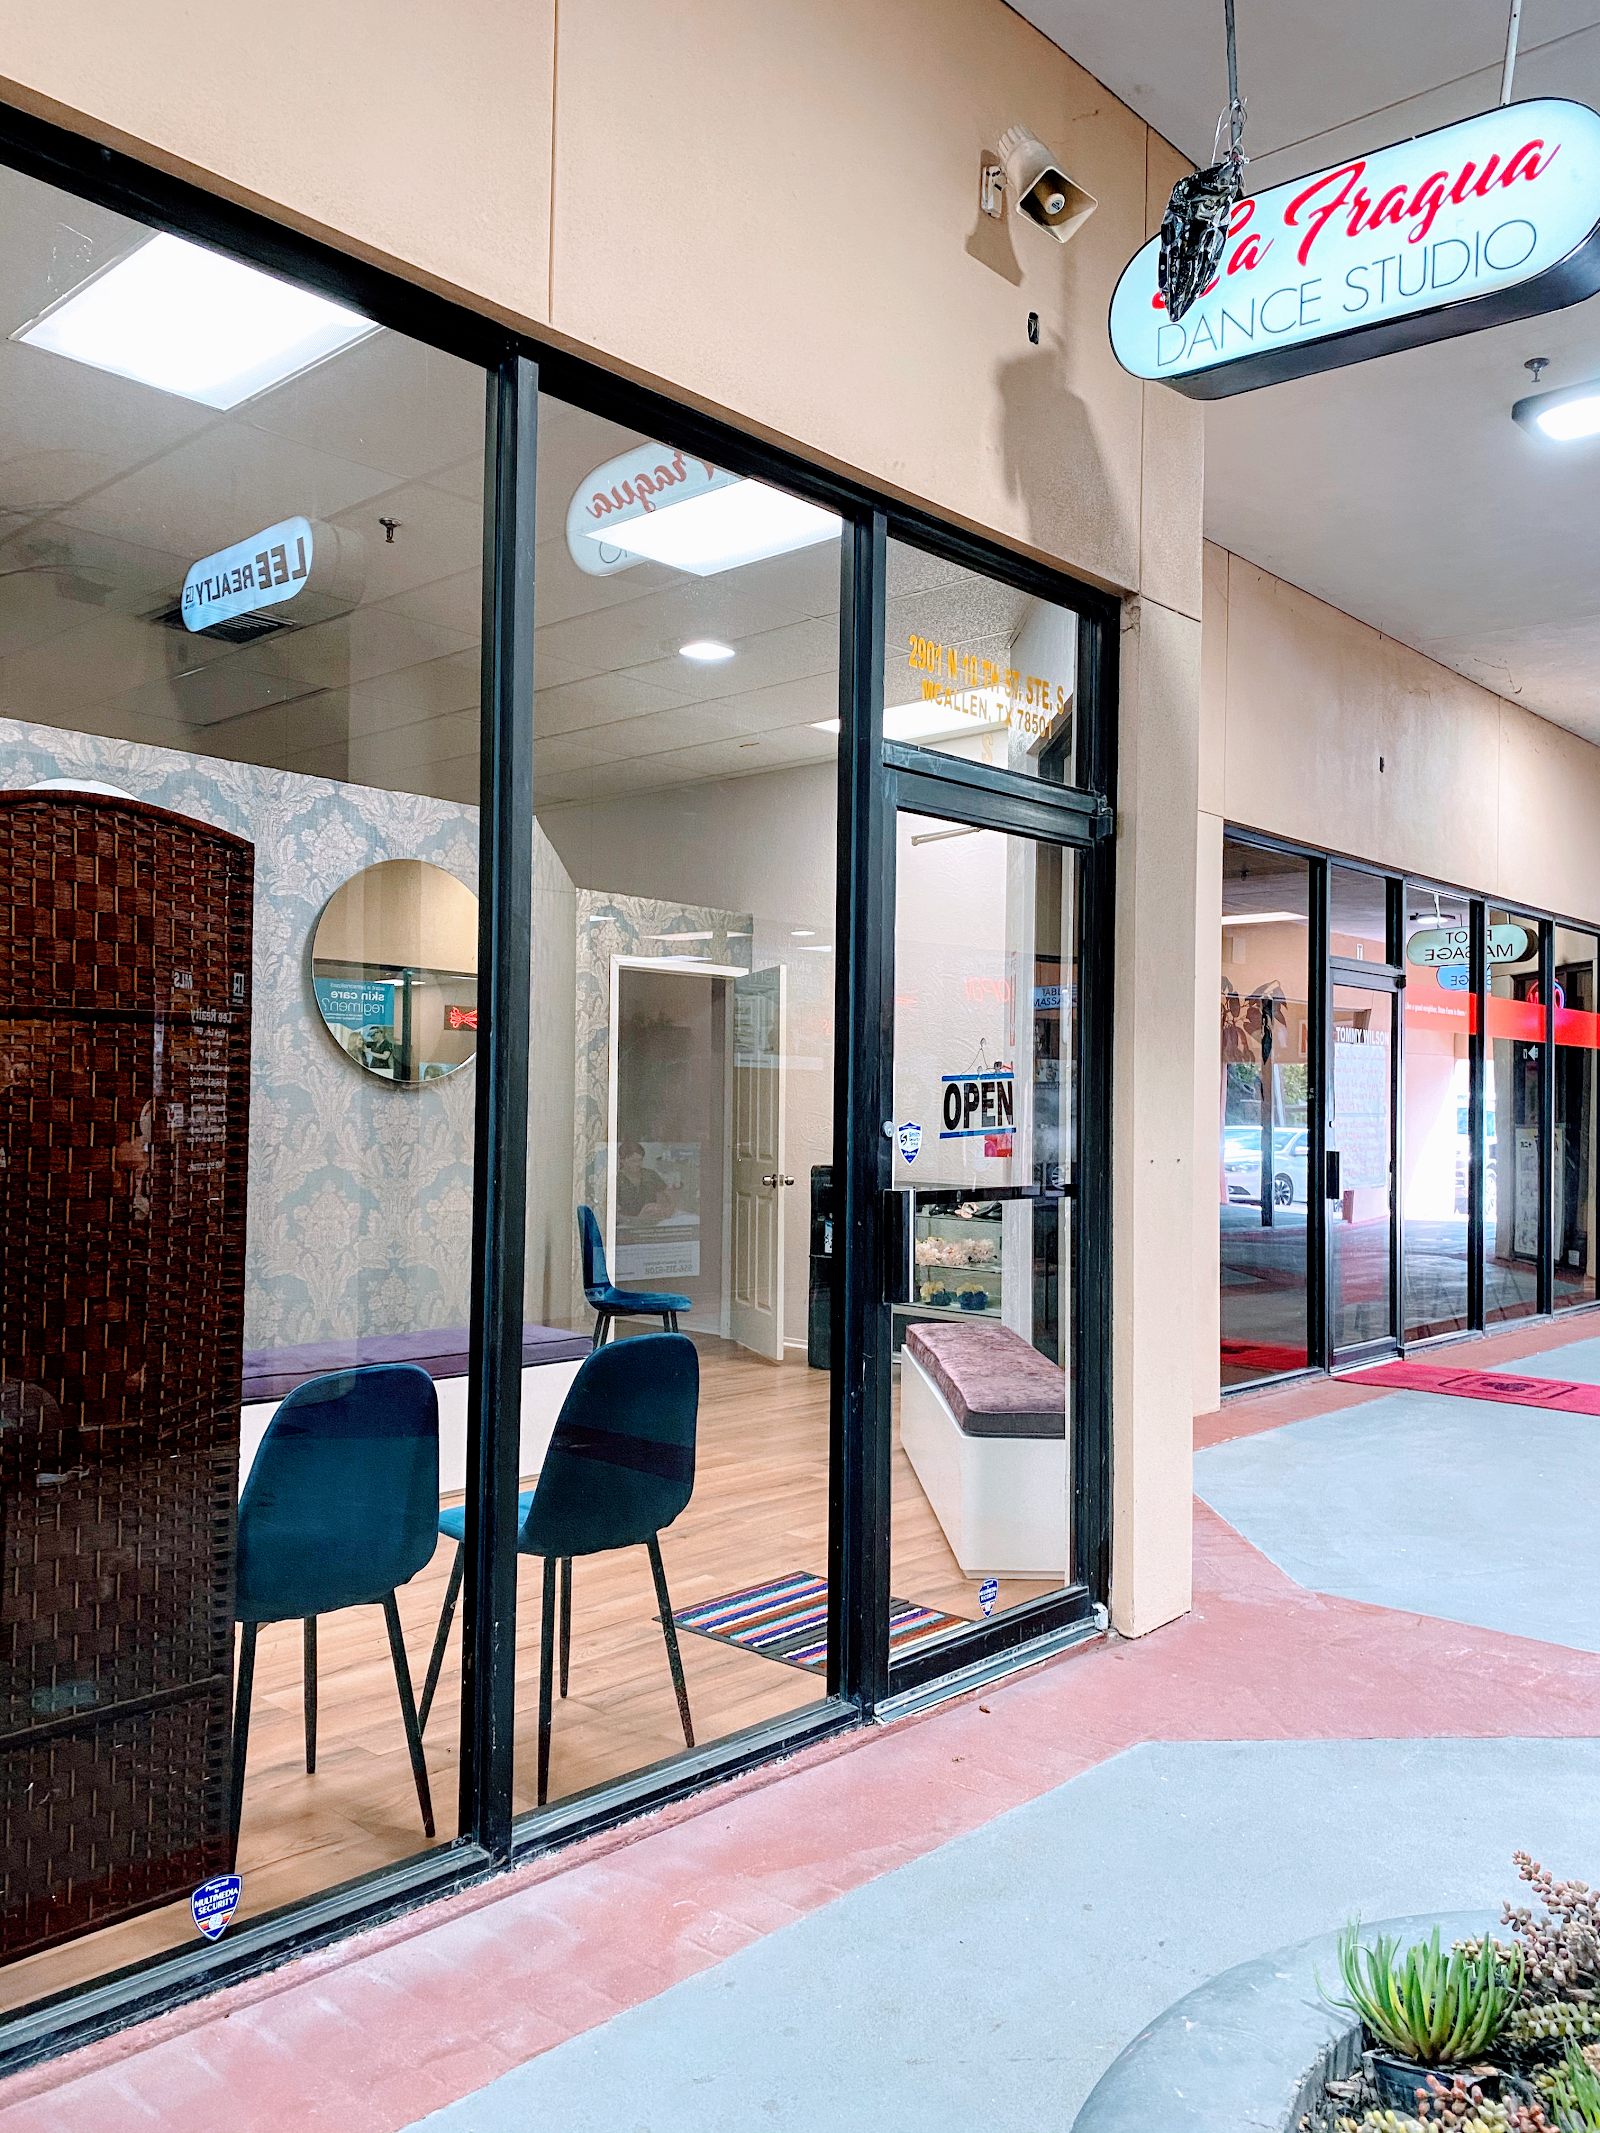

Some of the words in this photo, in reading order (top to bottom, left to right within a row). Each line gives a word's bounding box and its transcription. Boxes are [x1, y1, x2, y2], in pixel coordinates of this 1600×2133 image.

[1283, 137, 1561, 267] Fragua
[1156, 277, 1322, 368] DANCE
[1342, 218, 1538, 312] STUDIO
[908, 634, 943, 676] 2901
[947, 647, 958, 680] N
[962, 653, 978, 687] 10
[981, 659, 1000, 694] TH
[1025, 675, 1052, 711] STE.
[1056, 684, 1065, 715] S
[921, 678, 992, 724] MCALLEN,
[996, 703, 1013, 727] TX
[1017, 709, 1053, 739] 78501
[1335, 1026, 1362, 1044] TOMMY
[1362, 1029, 1390, 1046] WILSON
[943, 1080, 1014, 1131] OPEN
[194, 1888, 238, 1908] MULTIMEDIA
[198, 1896, 236, 1916] SECURITY
